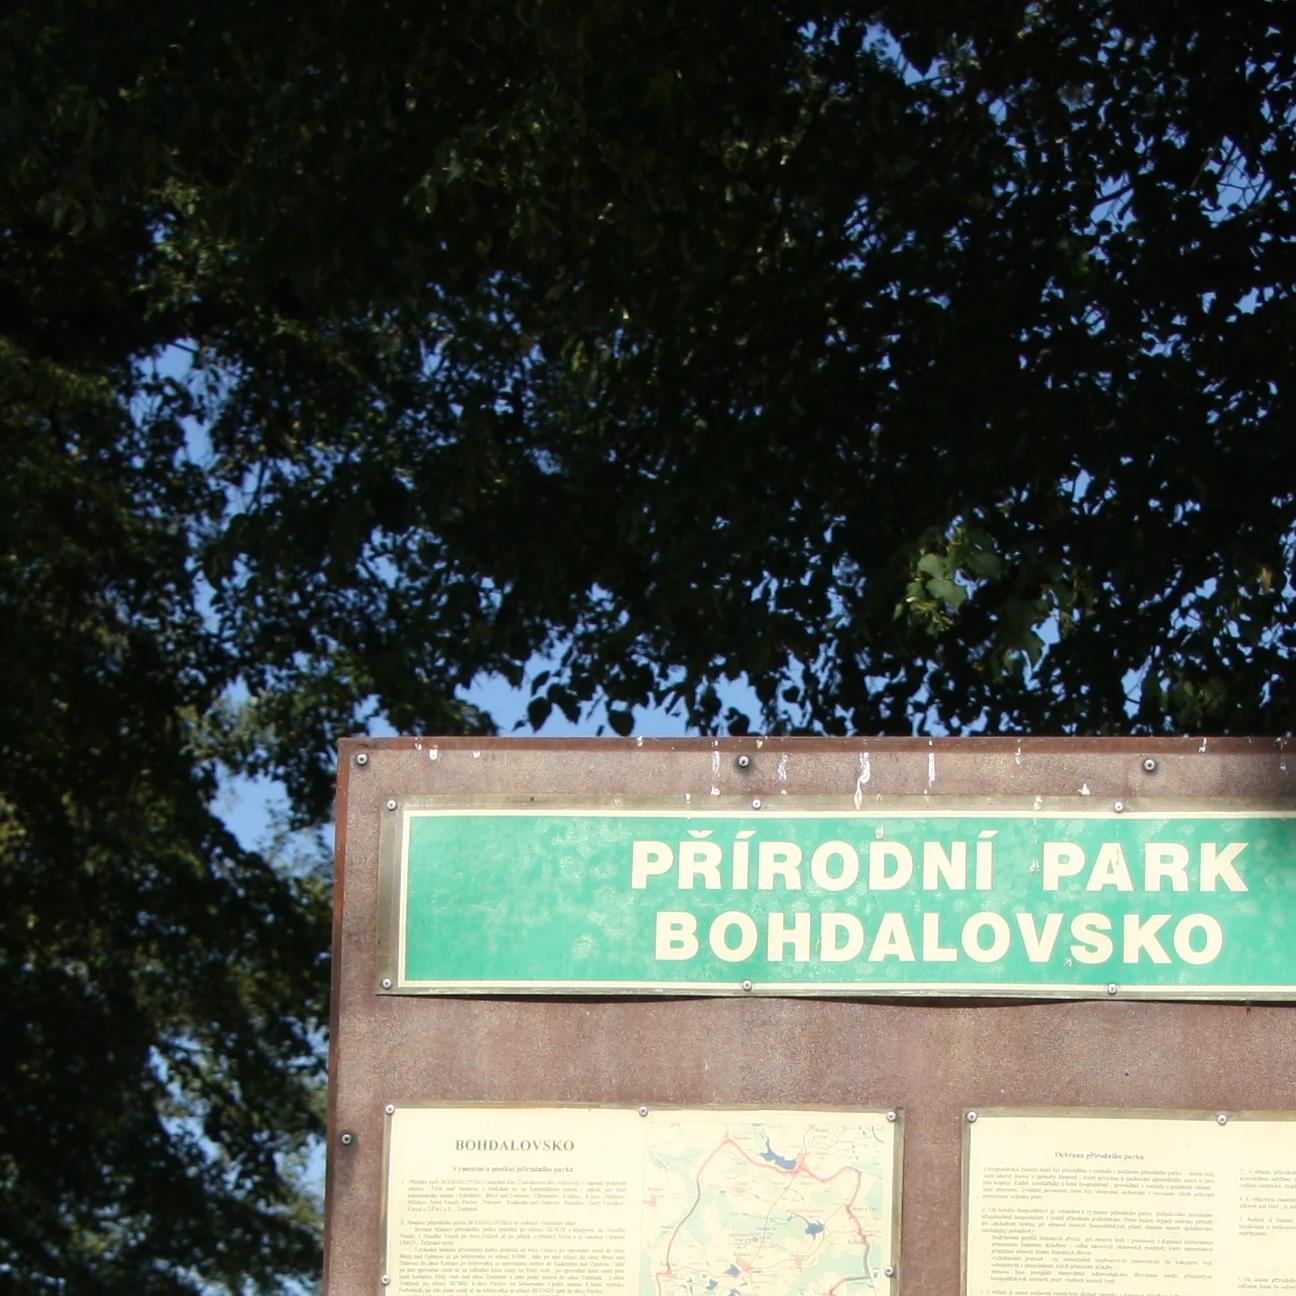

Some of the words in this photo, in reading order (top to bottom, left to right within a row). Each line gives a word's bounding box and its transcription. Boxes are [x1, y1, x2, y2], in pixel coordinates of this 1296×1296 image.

[630, 829, 1001, 891] PŘÍRODNÍ
[1042, 841, 1250, 892] PARK
[654, 909, 1224, 965] BOHDALOVSKO
[455, 1138, 575, 1152] BOHDALOVSKO
